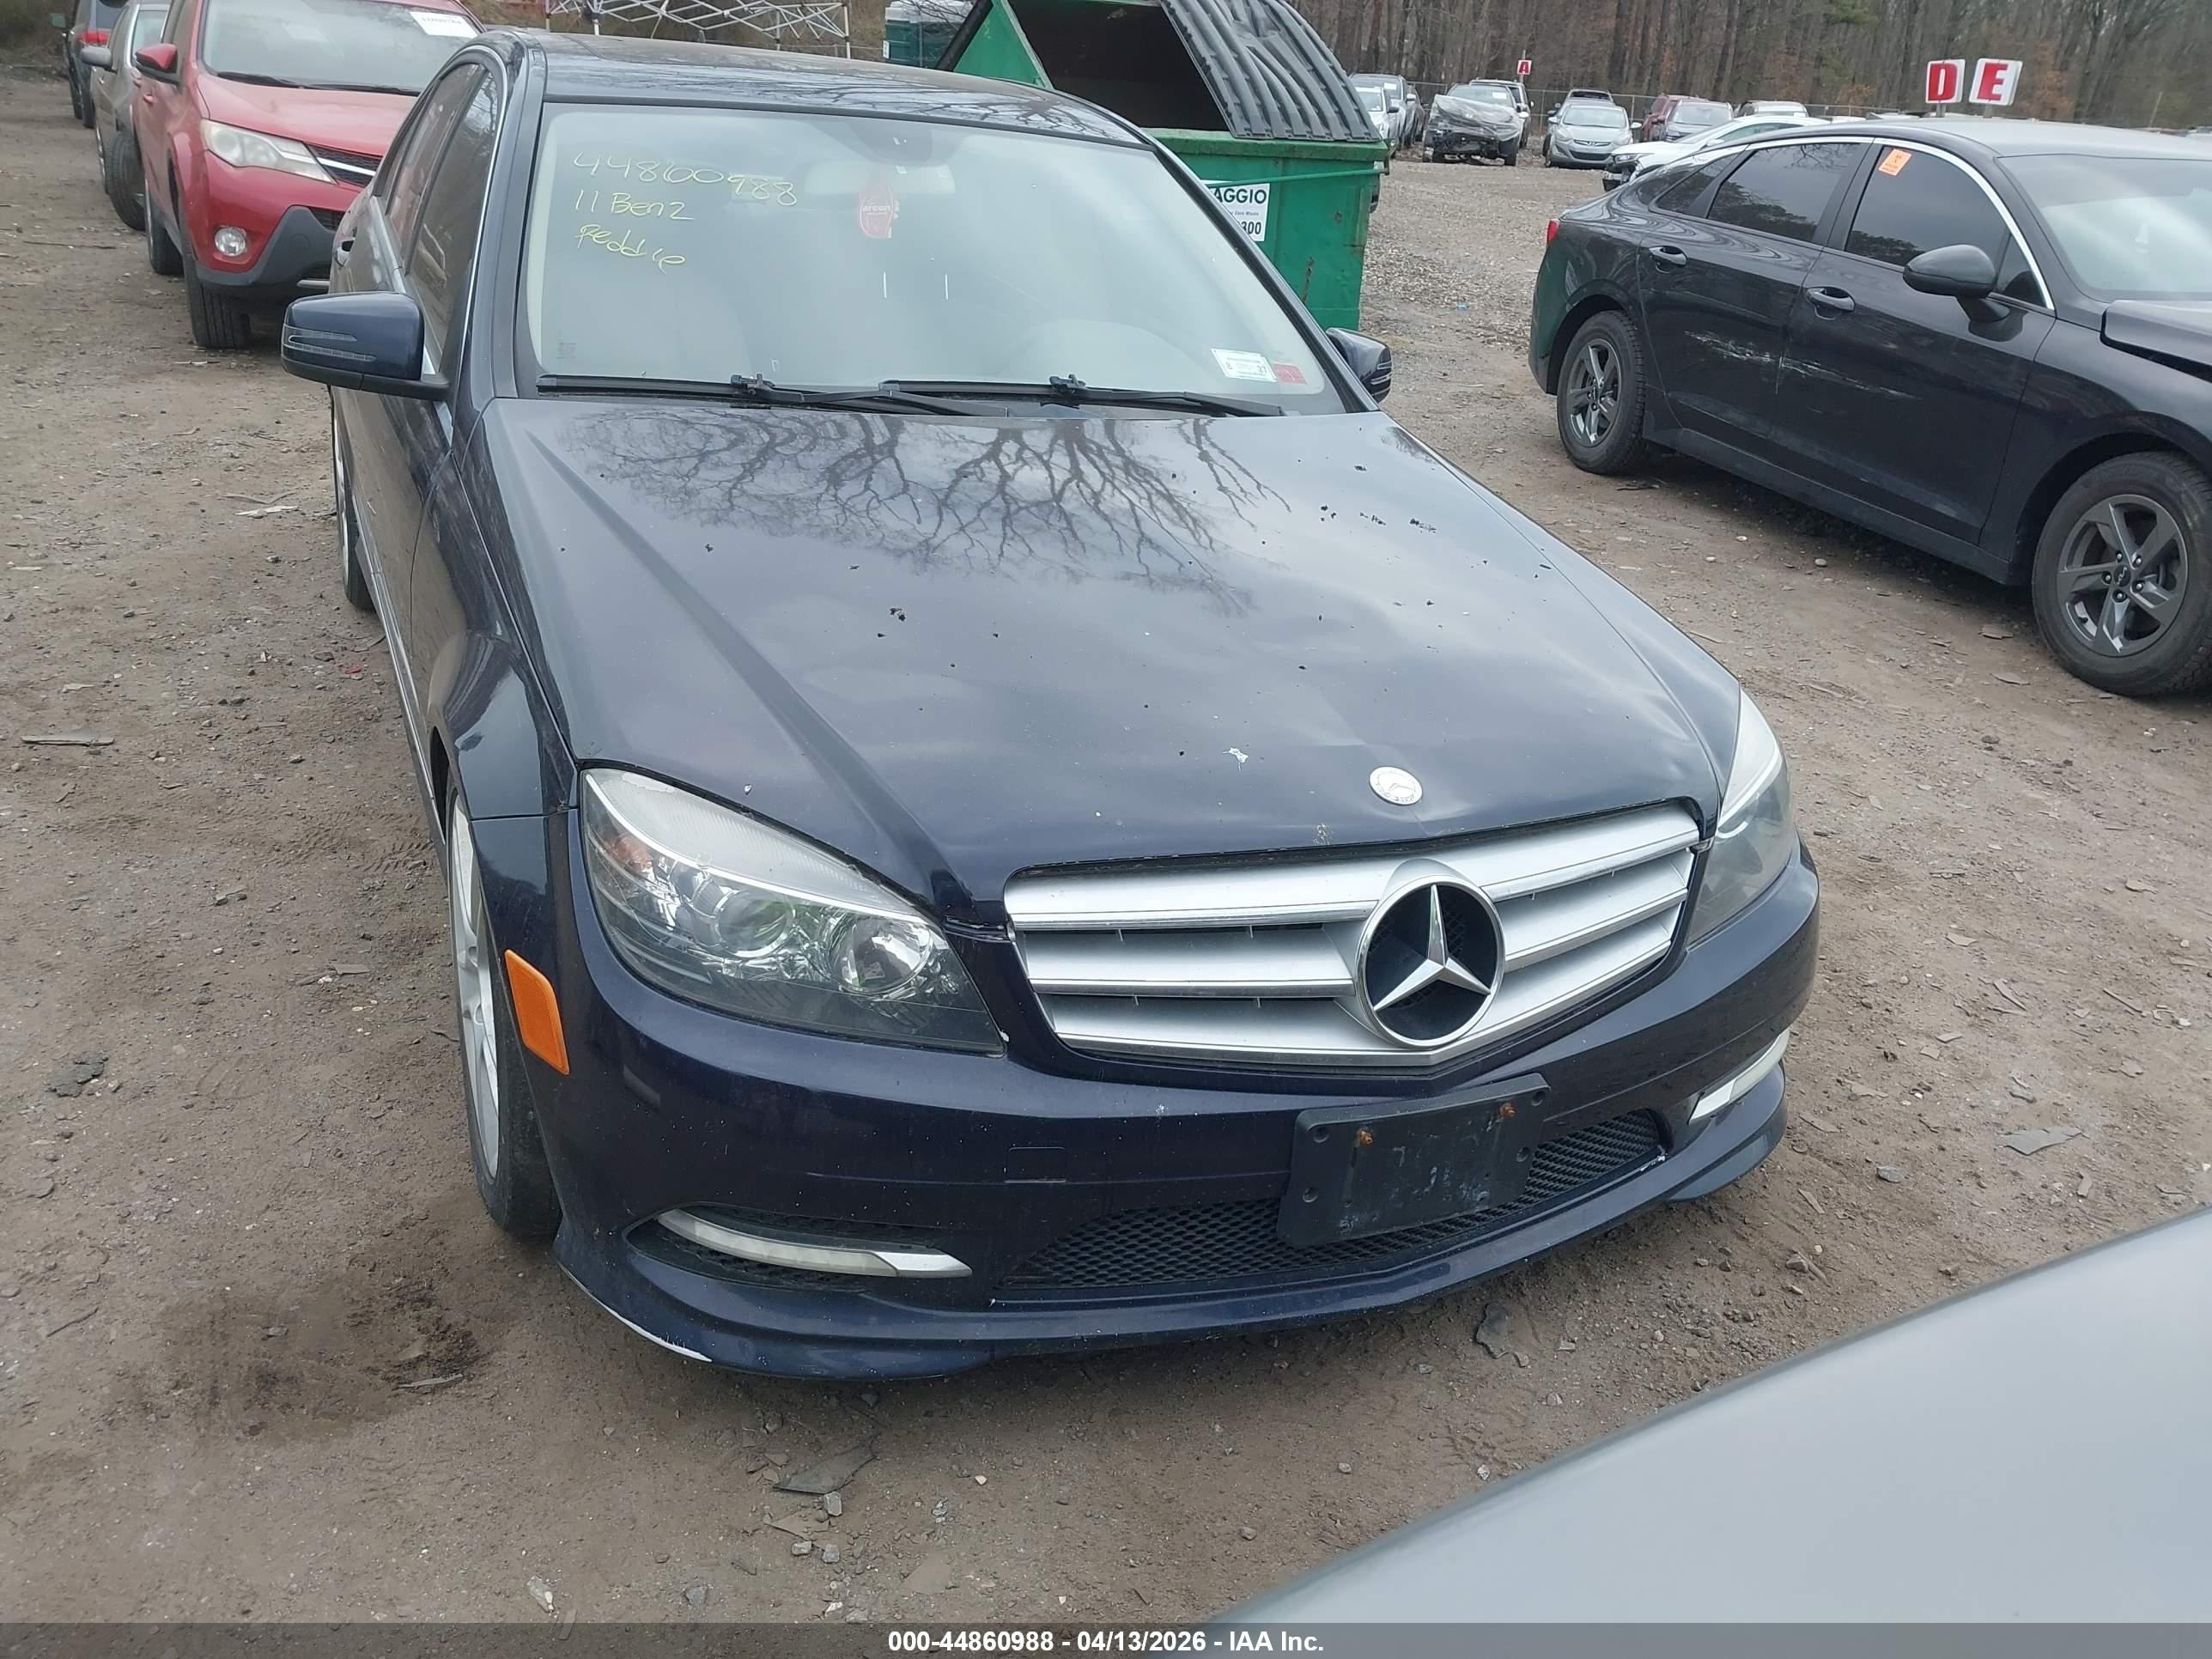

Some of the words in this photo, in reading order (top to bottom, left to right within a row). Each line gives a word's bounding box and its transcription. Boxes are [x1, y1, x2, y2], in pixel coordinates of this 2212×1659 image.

[1518, 61, 1529, 74] A
[1928, 64, 1957, 100] D
[1978, 63, 2009, 100] E
[574, 152, 797, 206] 44860988
[575, 189, 599, 212] 11
